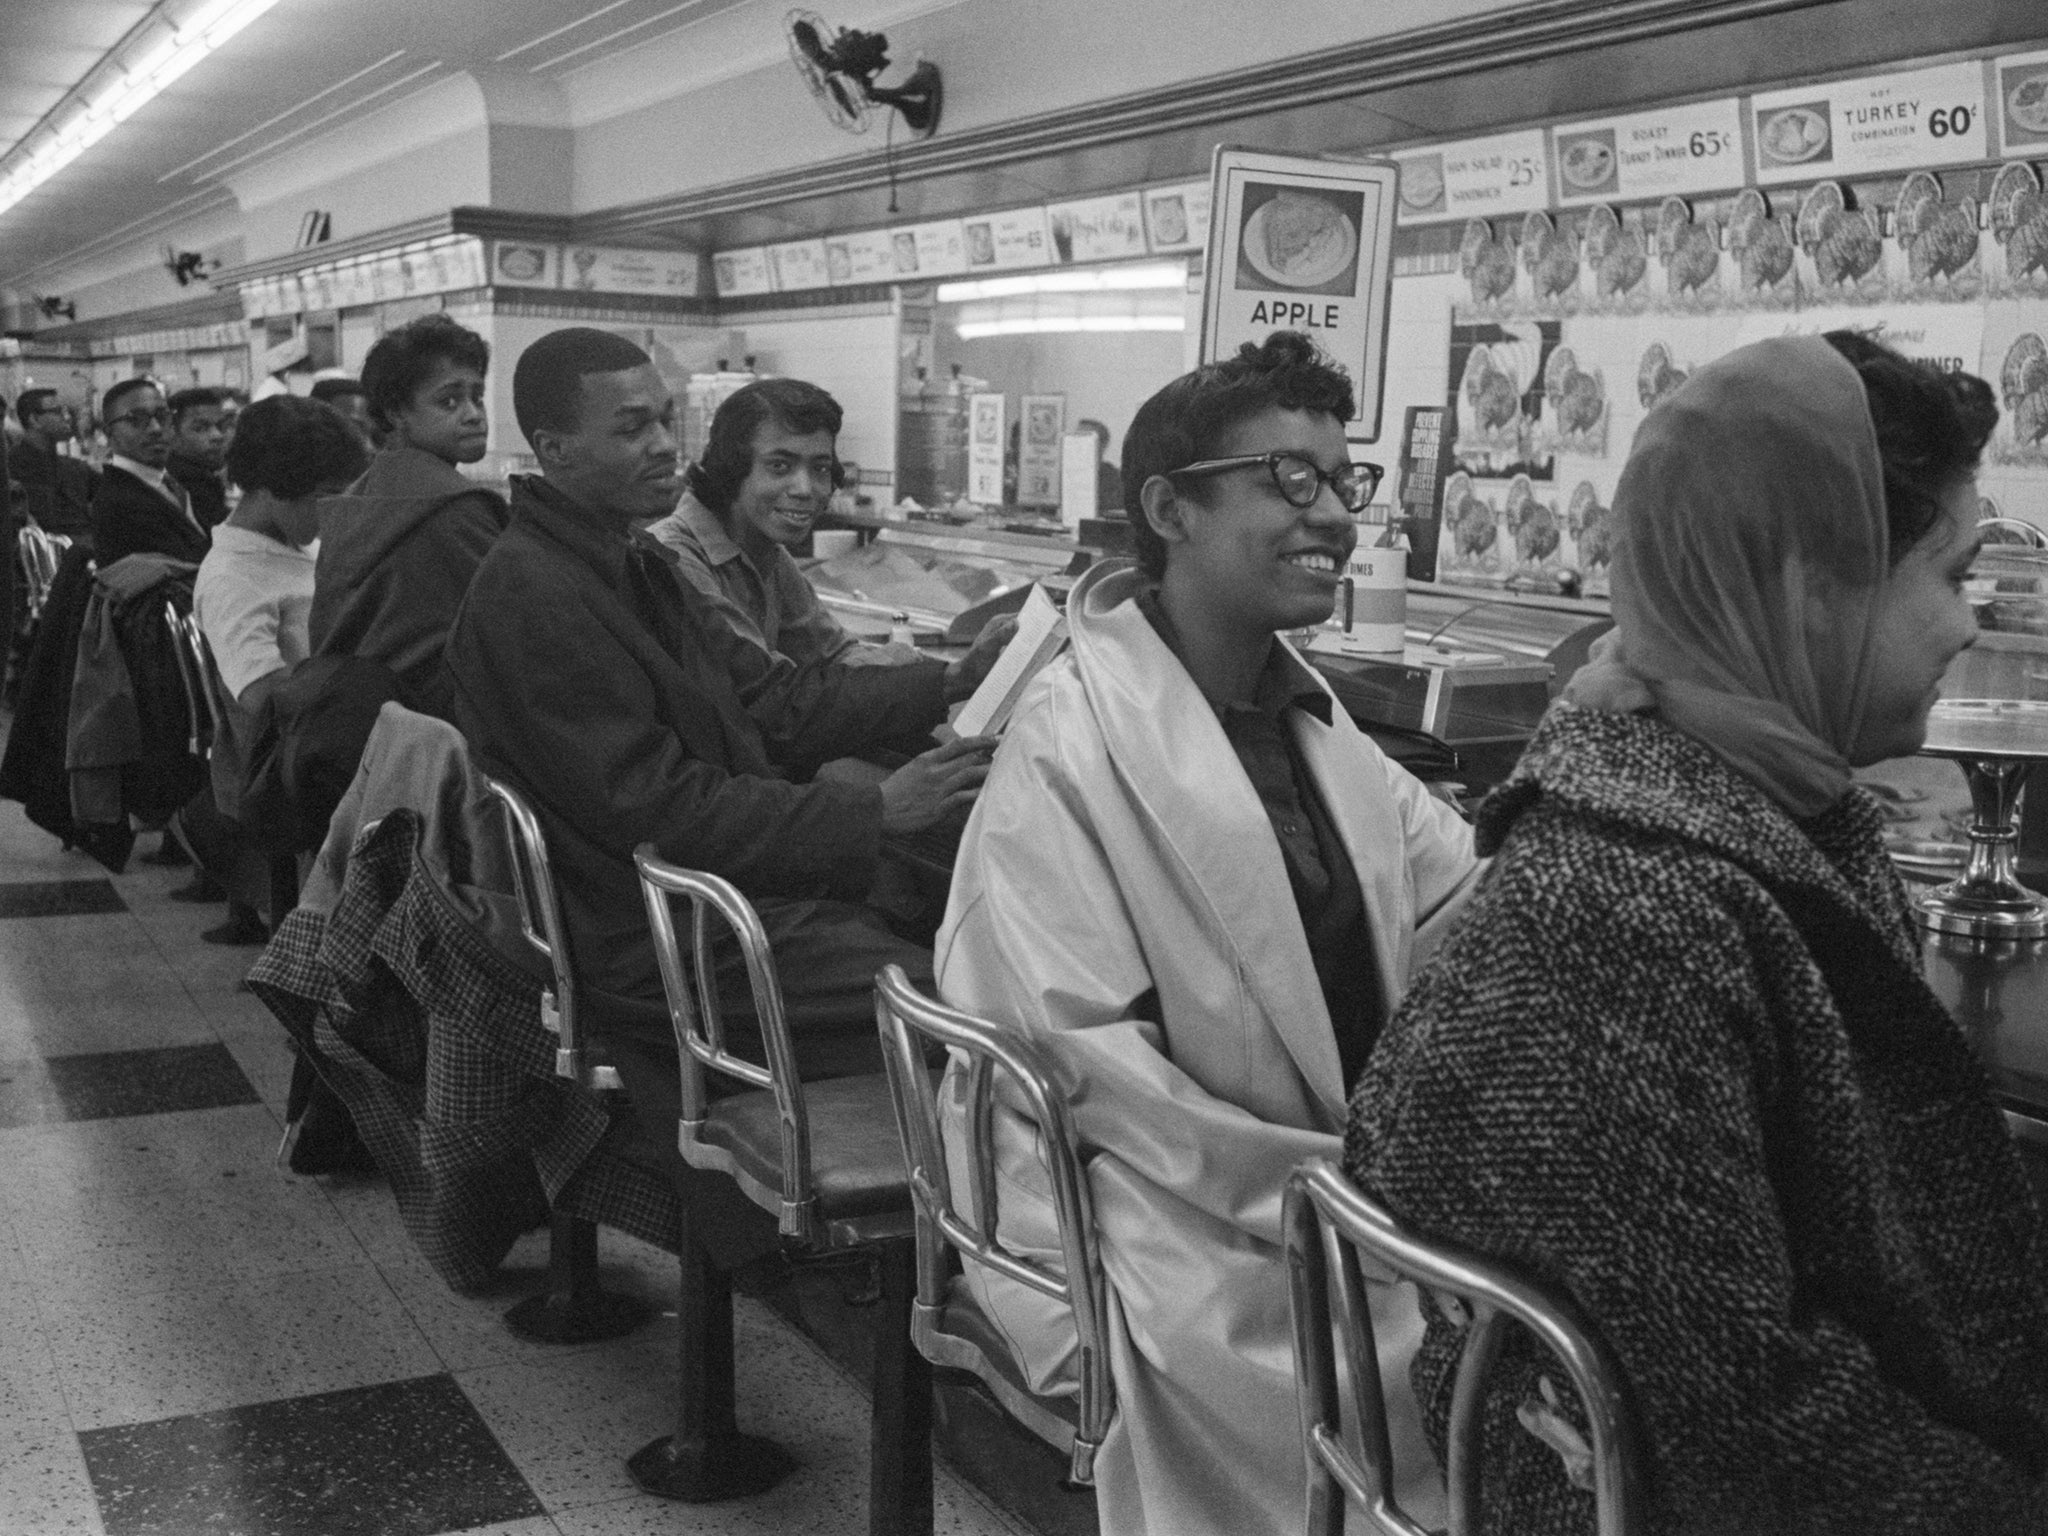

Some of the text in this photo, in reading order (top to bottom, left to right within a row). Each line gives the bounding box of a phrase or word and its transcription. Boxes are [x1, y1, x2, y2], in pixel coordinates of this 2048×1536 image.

[1844, 100, 1920, 126] TURKEY
[1851, 125, 1916, 142] COMBINATION
[1250, 300, 1339, 329] APPLE
